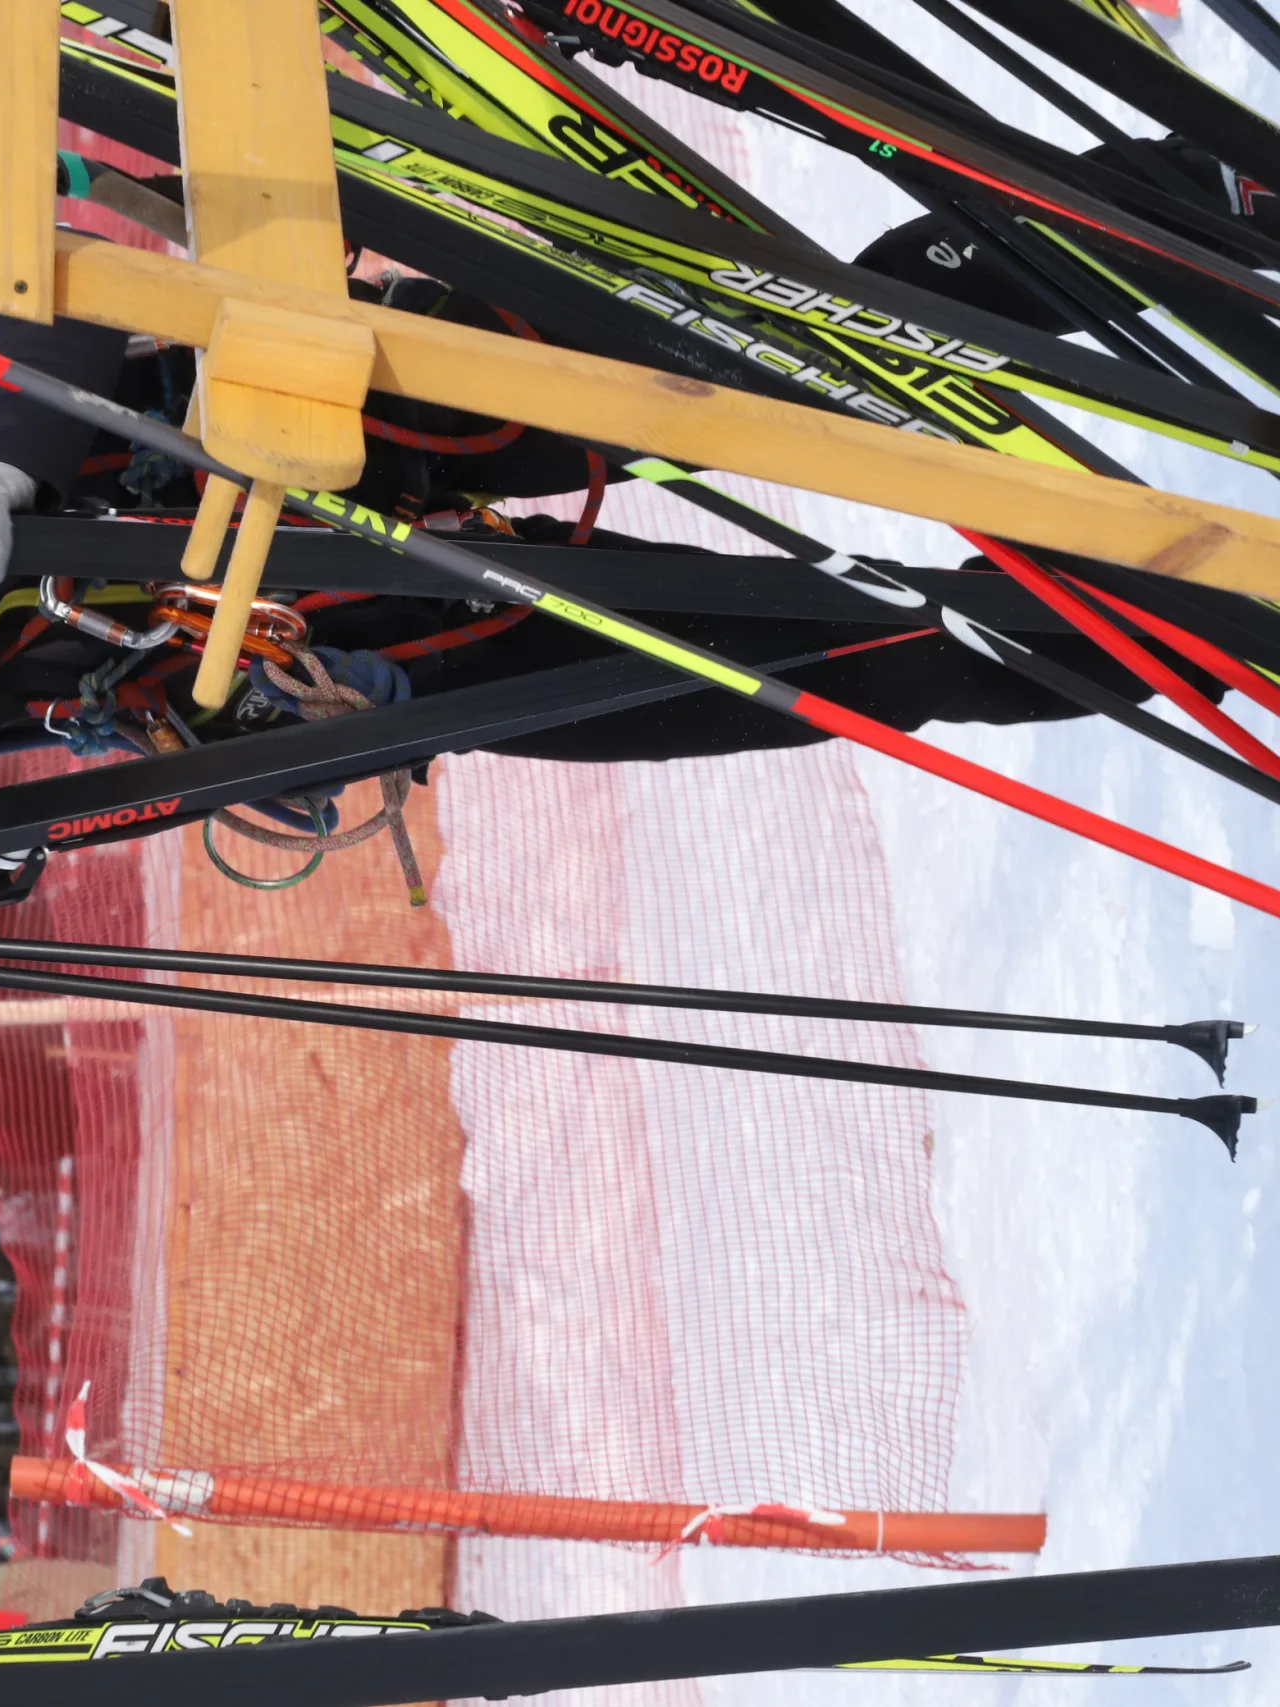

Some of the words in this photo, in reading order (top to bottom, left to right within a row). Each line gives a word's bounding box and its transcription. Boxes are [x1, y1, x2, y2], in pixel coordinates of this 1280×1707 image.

[869, 140, 897, 158] S1
[710, 262, 1011, 372] FISCHER
[48, 797, 182, 840] ATOMIC
[14, 1631, 64, 1646] CARBON
[65, 1629, 93, 1643] LITE
